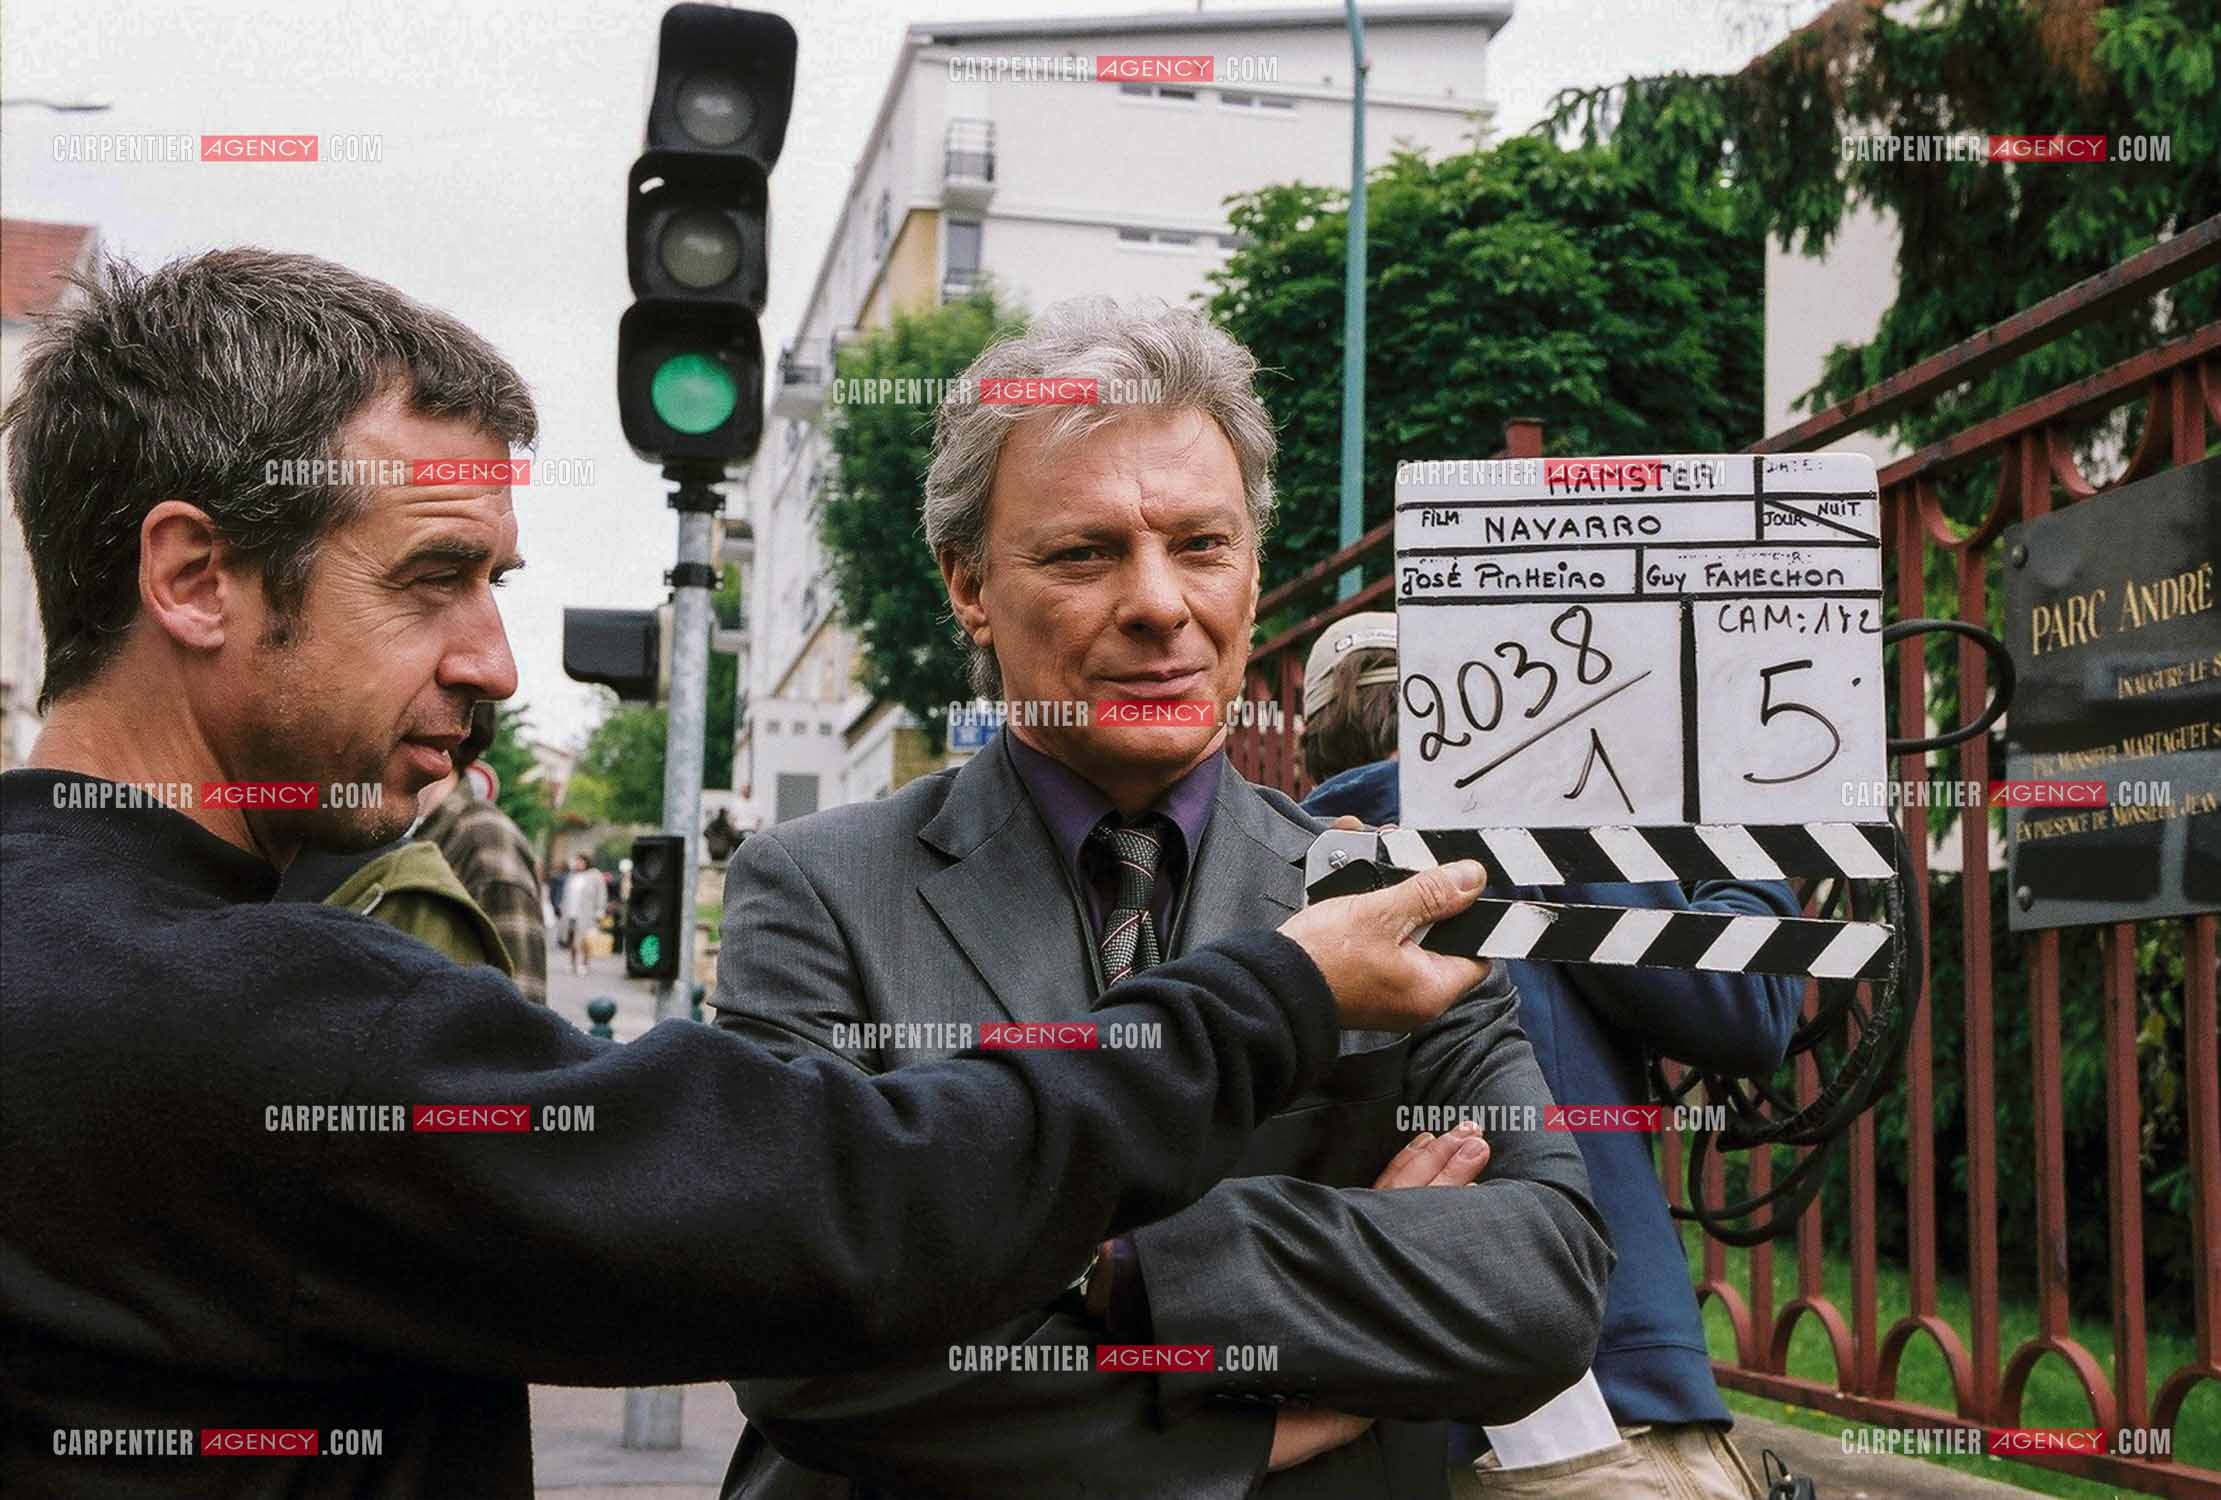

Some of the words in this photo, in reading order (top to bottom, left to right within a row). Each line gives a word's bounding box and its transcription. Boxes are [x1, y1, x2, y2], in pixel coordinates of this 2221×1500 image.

[1549, 463, 1714, 495] HAMSTER
[1485, 515, 1661, 543] NAVARRO
[2032, 588, 2107, 656] PARC
